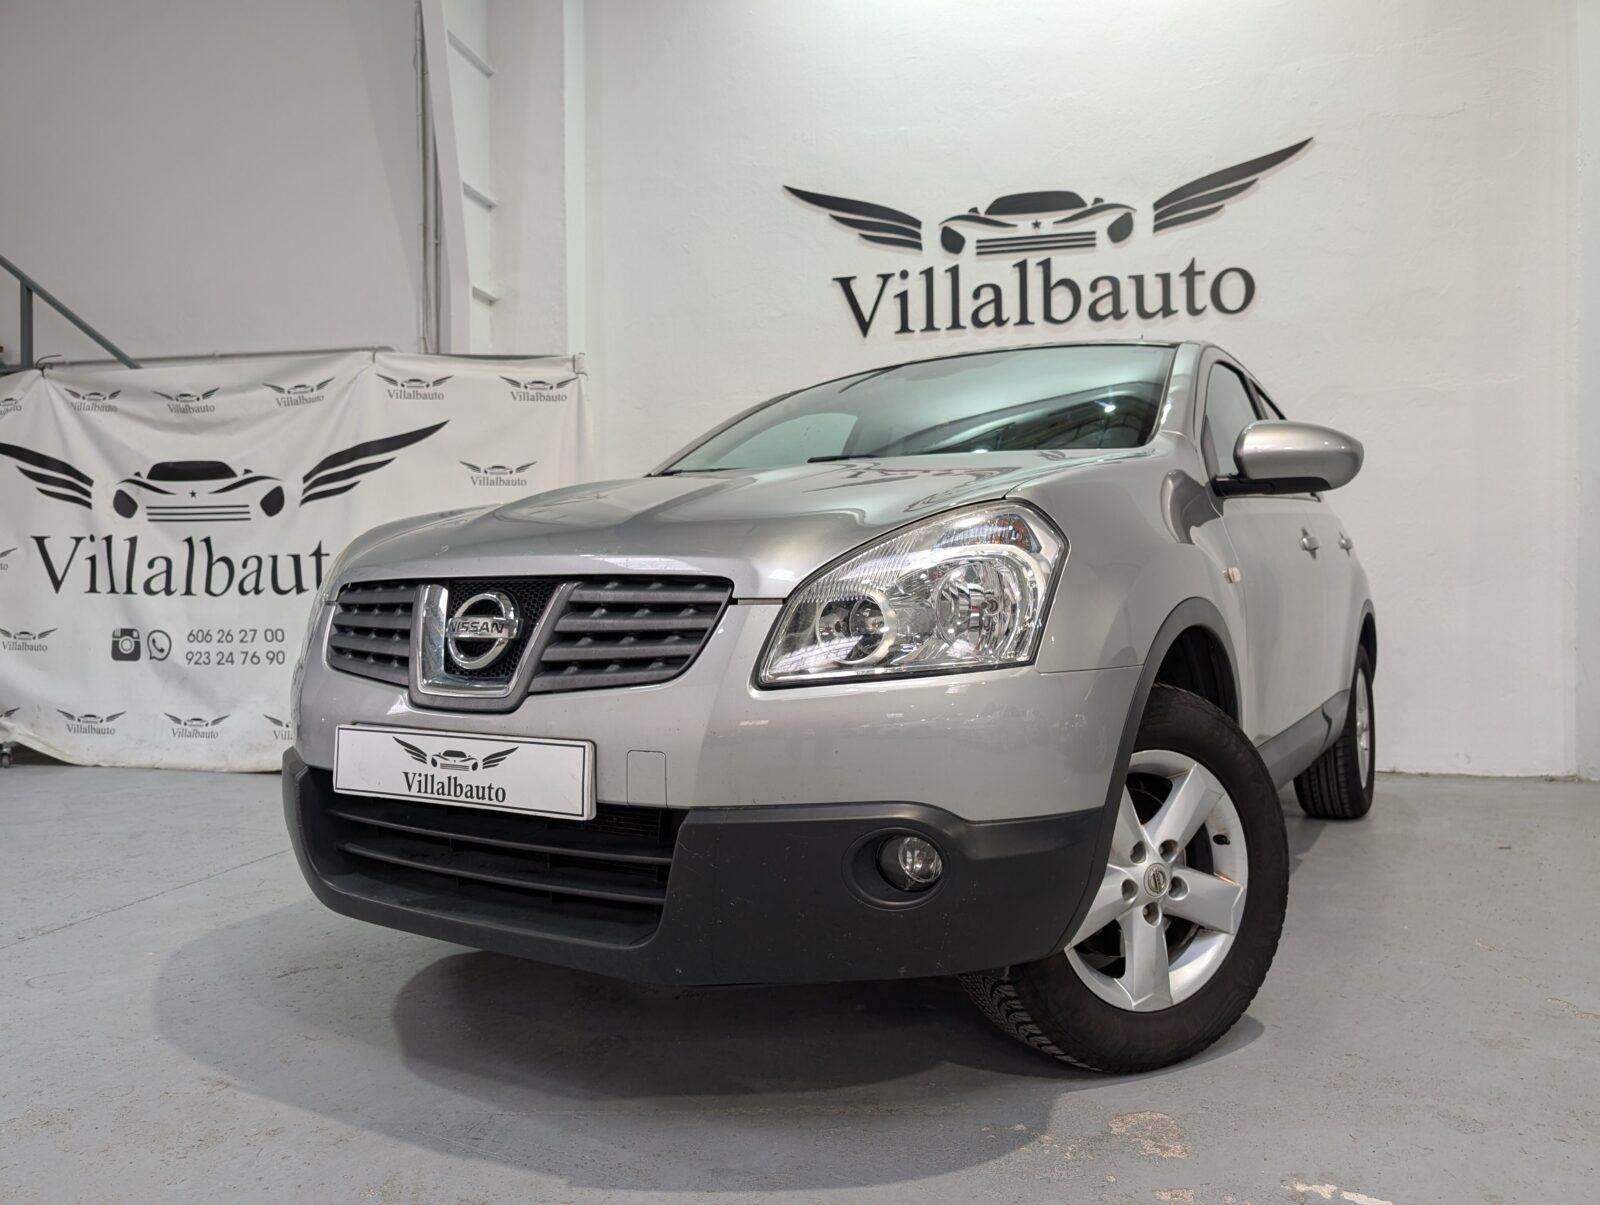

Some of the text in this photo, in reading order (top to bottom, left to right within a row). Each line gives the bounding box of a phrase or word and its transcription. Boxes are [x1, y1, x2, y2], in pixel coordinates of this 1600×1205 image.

[832, 256, 1257, 338] Villalbauto
[275, 394, 325, 408] Villalbauto
[386, 389, 445, 401] Villalbauto
[510, 390, 568, 403] Villalbauto
[167, 403, 216, 414] Villalbauto
[471, 475, 528, 487] Villalbauto
[31, 534, 330, 597] Villalbaut
[451, 620, 505, 634] NISSAN
[187, 628, 285, 643] 606 26 27 00
[2, 641, 48, 652] Villalbauto
[185, 650, 286, 665] 923 24 76 90
[66, 723, 116, 735] Villalbauto
[171, 727, 219, 740] Villalbauto
[402, 771, 507, 803] Villalbauto
